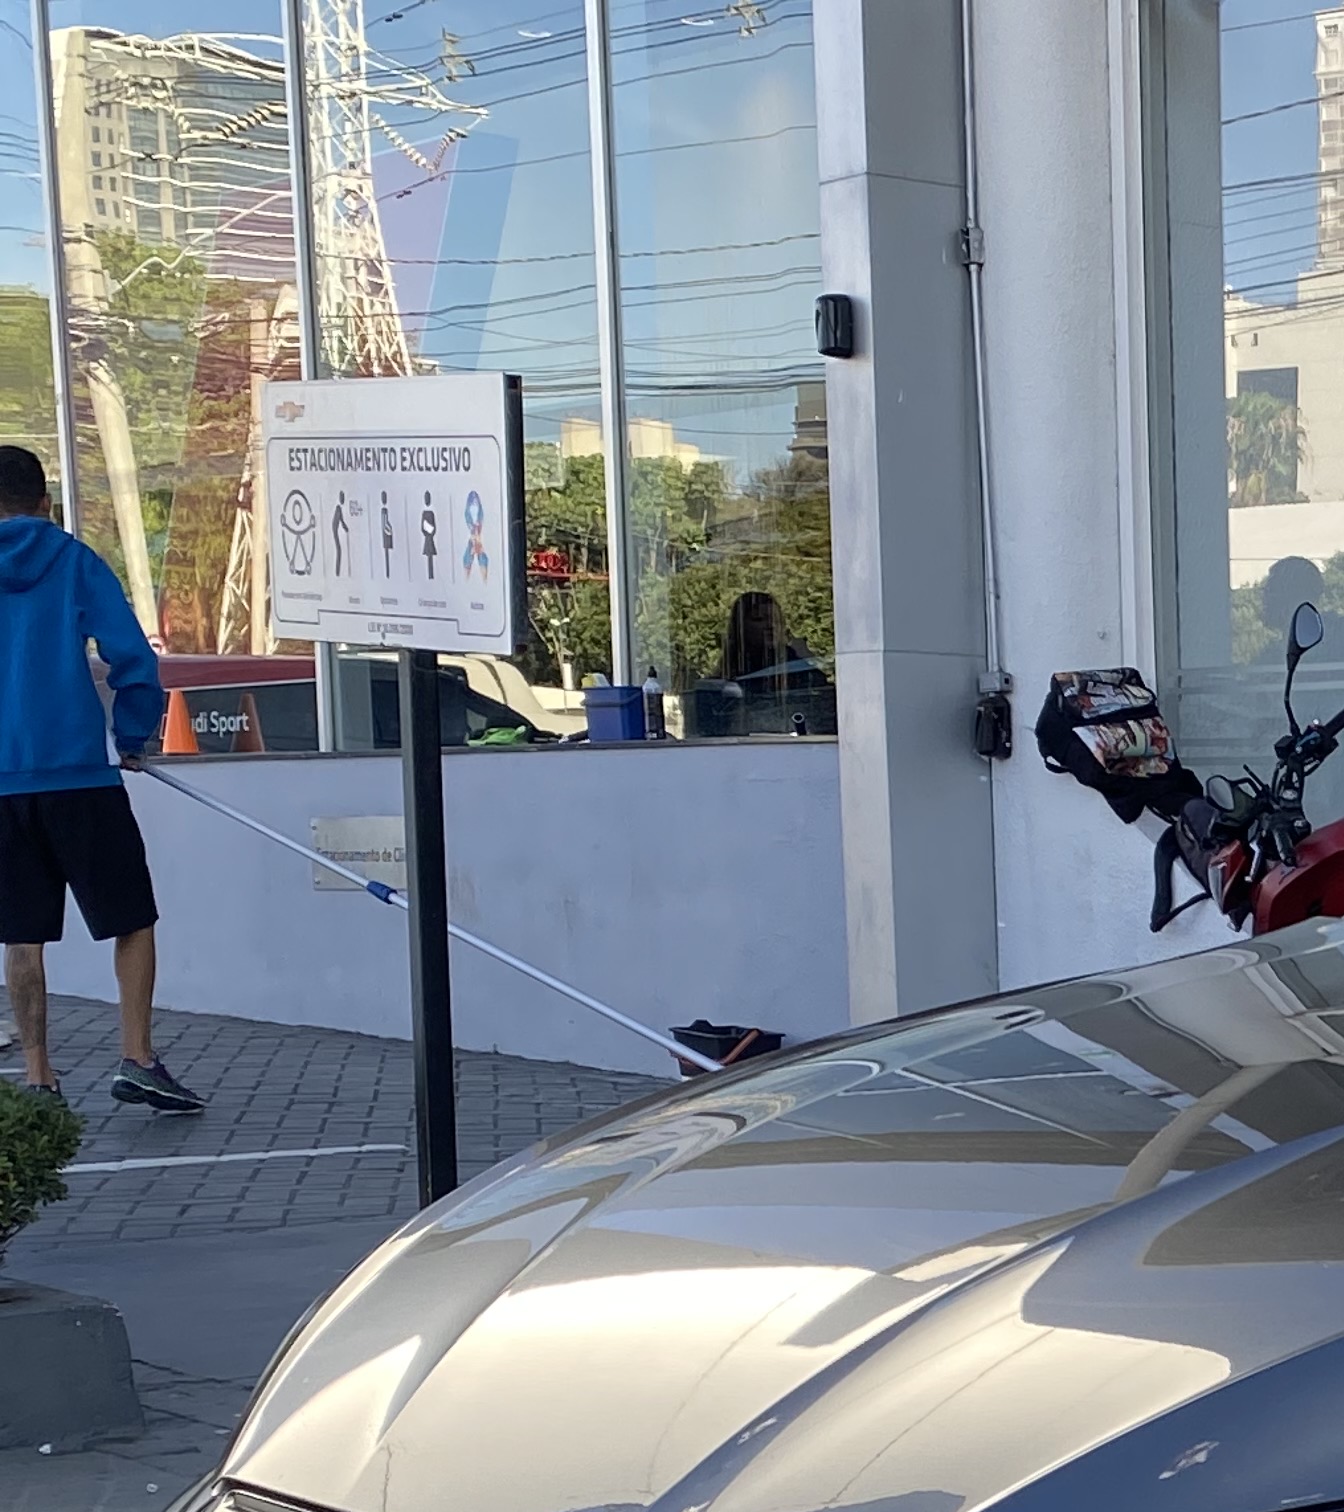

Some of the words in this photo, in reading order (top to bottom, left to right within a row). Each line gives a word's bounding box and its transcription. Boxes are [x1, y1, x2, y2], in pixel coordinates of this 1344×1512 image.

[288, 447, 397, 472] ESTACIONAMENTO
[400, 446, 472, 472] EXCLUSIVO
[209, 710, 250, 738] Sport
